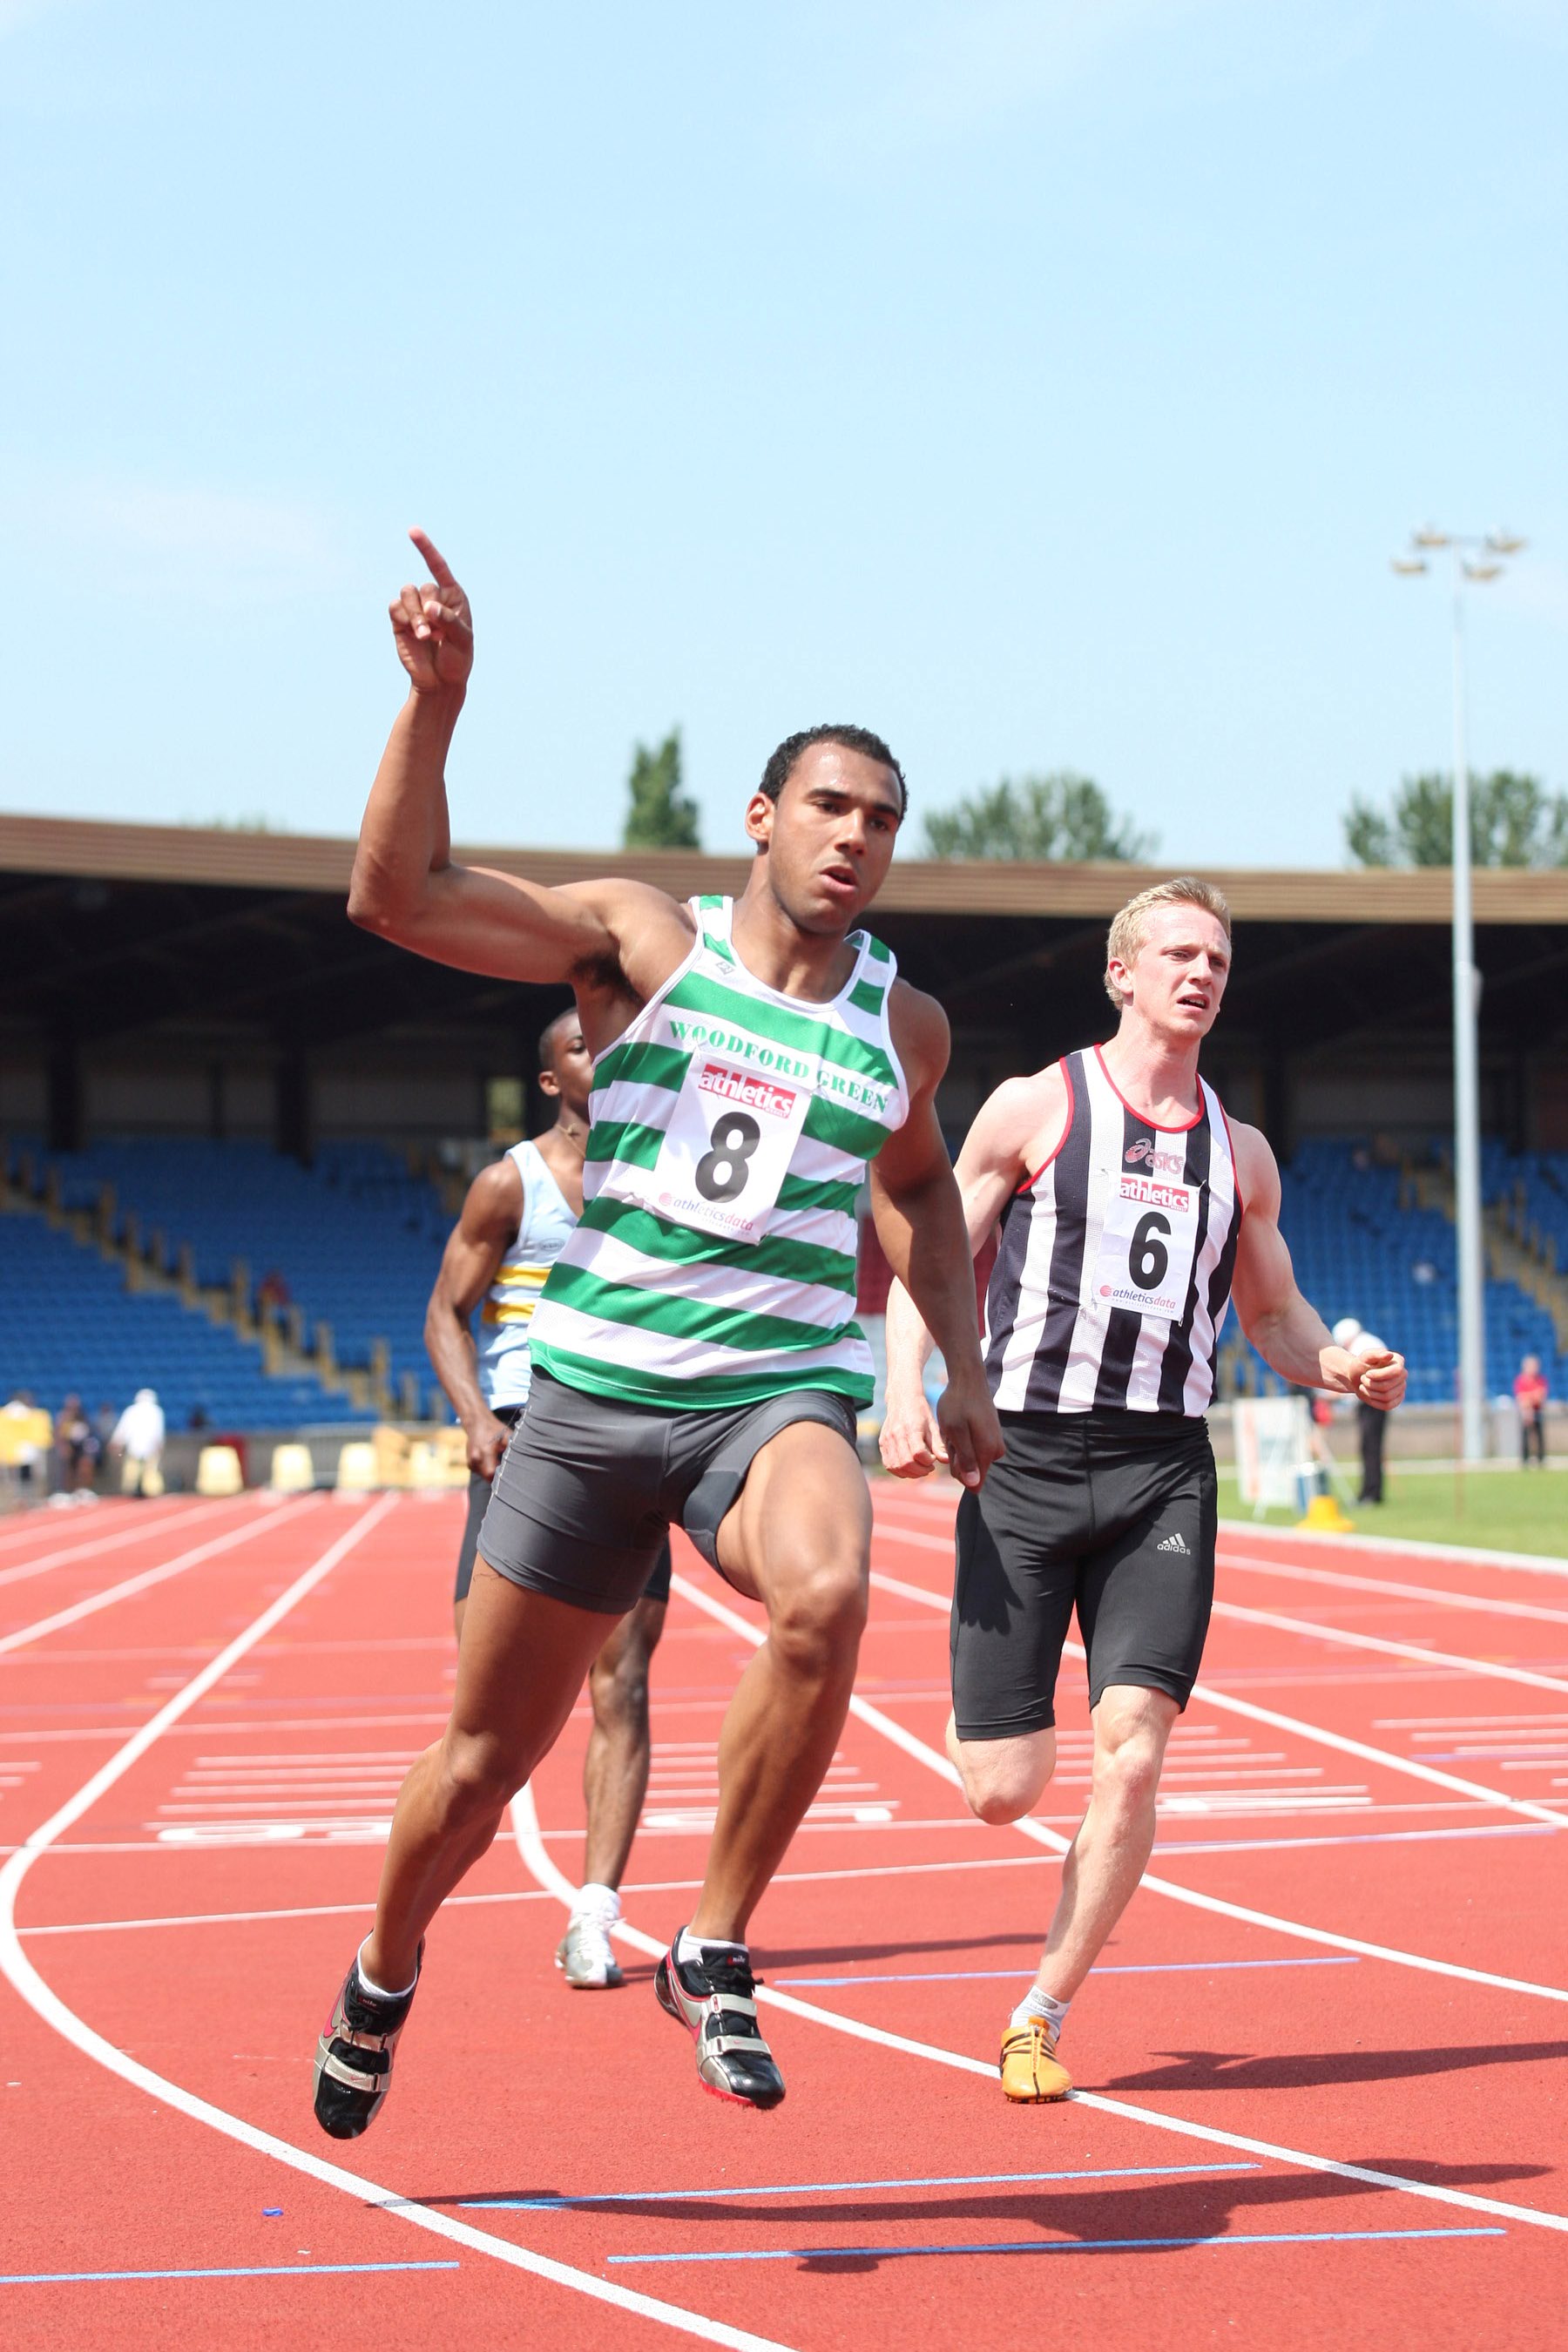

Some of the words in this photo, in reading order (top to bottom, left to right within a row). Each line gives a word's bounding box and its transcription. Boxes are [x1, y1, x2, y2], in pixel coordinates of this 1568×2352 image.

[669, 1019, 809, 1078] WOODFORD
[816, 1070, 889, 1113] GREEN
[700, 1062, 794, 1113] athletics
[694, 1111, 761, 1204] 8
[1120, 1179, 1188, 1209] athletics
[672, 1199, 754, 1232] athleticsdata
[1128, 1211, 1172, 1290] 6
[1112, 1288, 1177, 1309] athleticsdata
[1156, 1543, 1191, 1555] adidas
